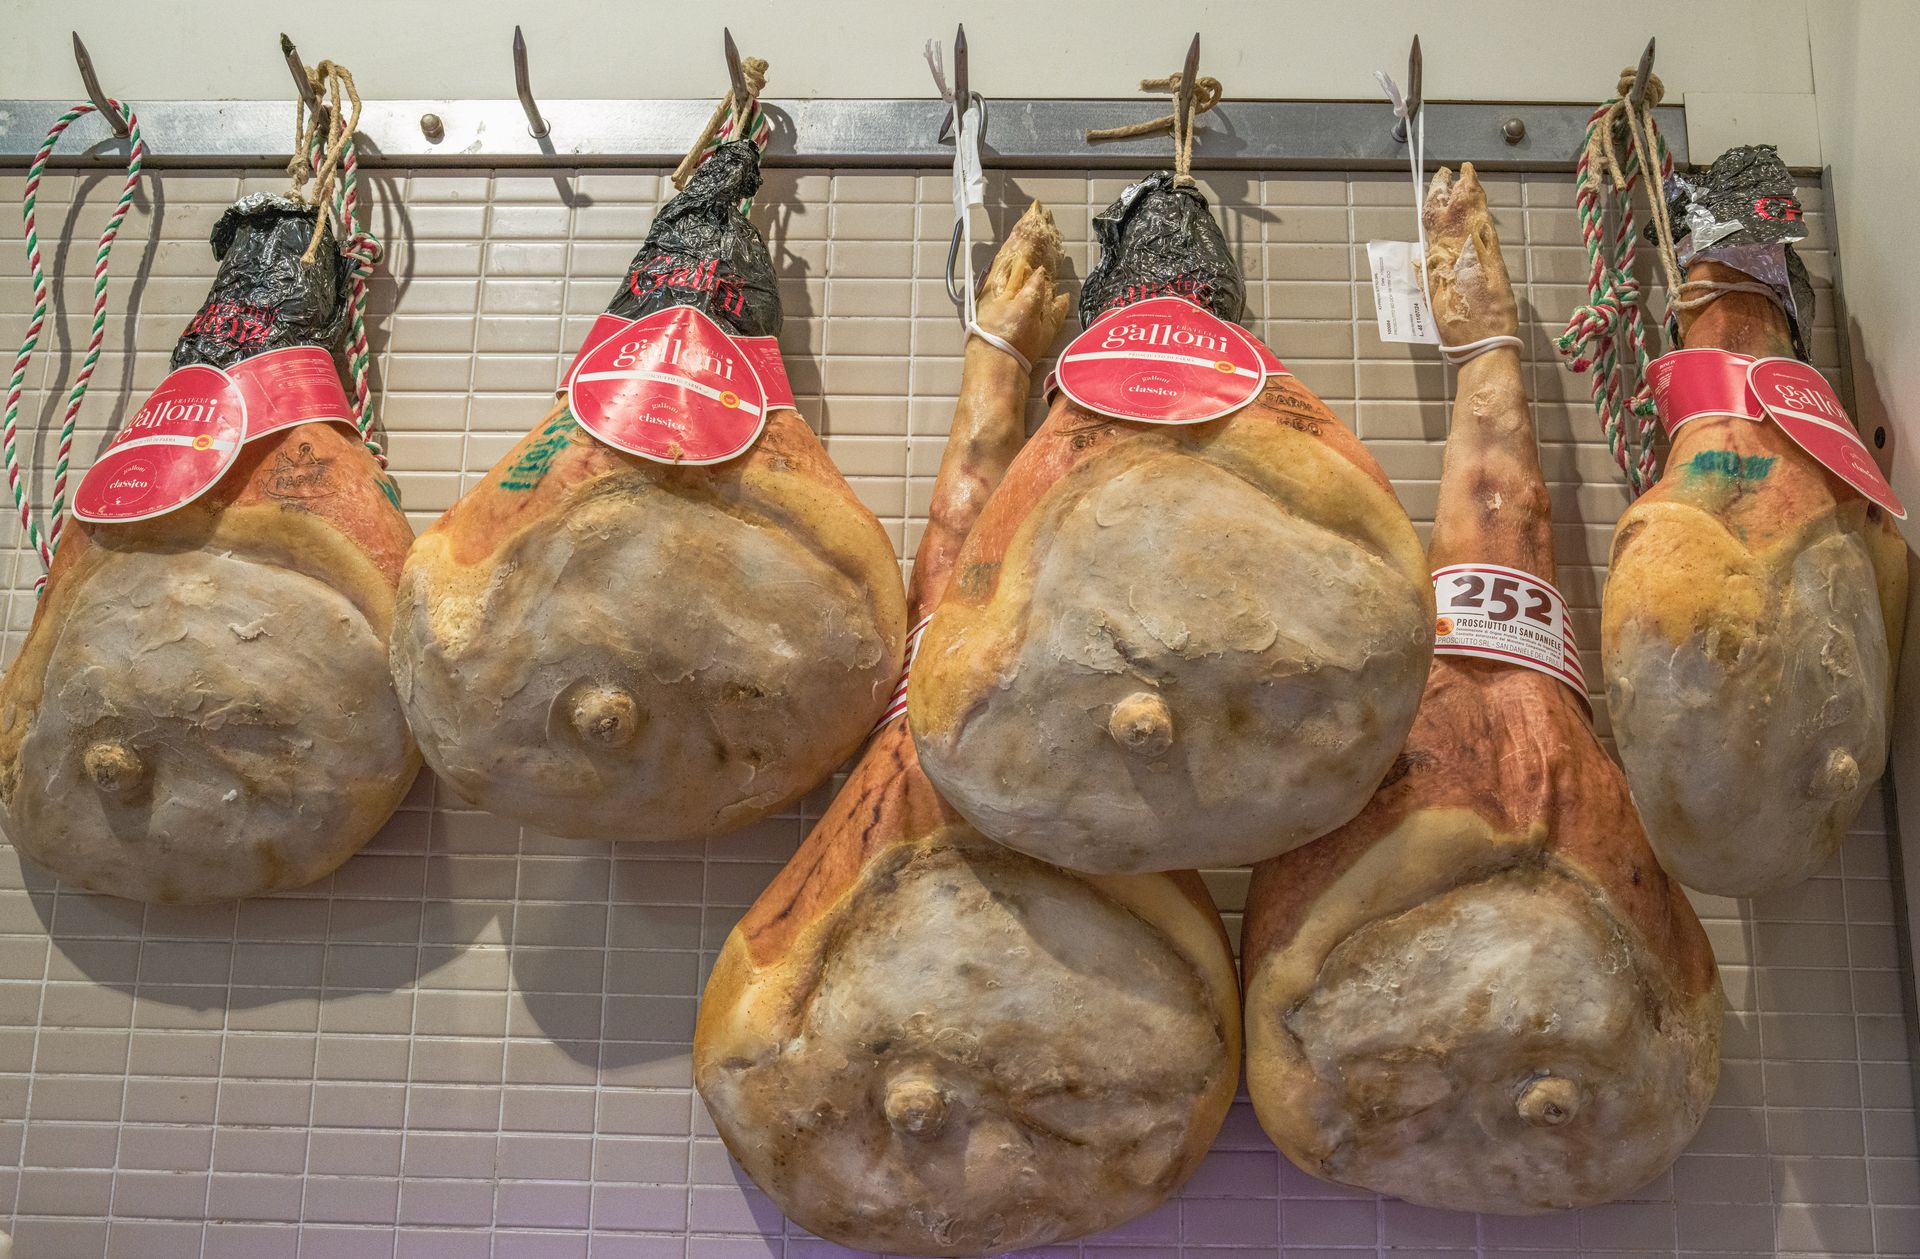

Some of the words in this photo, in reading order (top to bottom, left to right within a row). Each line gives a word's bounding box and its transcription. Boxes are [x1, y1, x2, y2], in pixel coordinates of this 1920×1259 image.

[1101, 323, 1228, 353] galloni
[612, 338, 737, 381] galloni
[1128, 384, 1177, 397] classico
[638, 412, 687, 432] classico
[109, 479, 149, 489] classico
[1450, 574, 1553, 627] 252
[1437, 636, 1478, 645] PROSCIUTTO
[1478, 639, 1490, 647] SRL
[1496, 641, 1509, 650] SAN
[1509, 644, 1534, 657] DANIELE
[1534, 651, 1545, 661] DEL
[1456, 618, 1507, 632] PROSCIUTTO
[1509, 625, 1517, 634] DI
[1519, 628, 1533, 639] SAN
[1535, 632, 1562, 652] DANIELE
